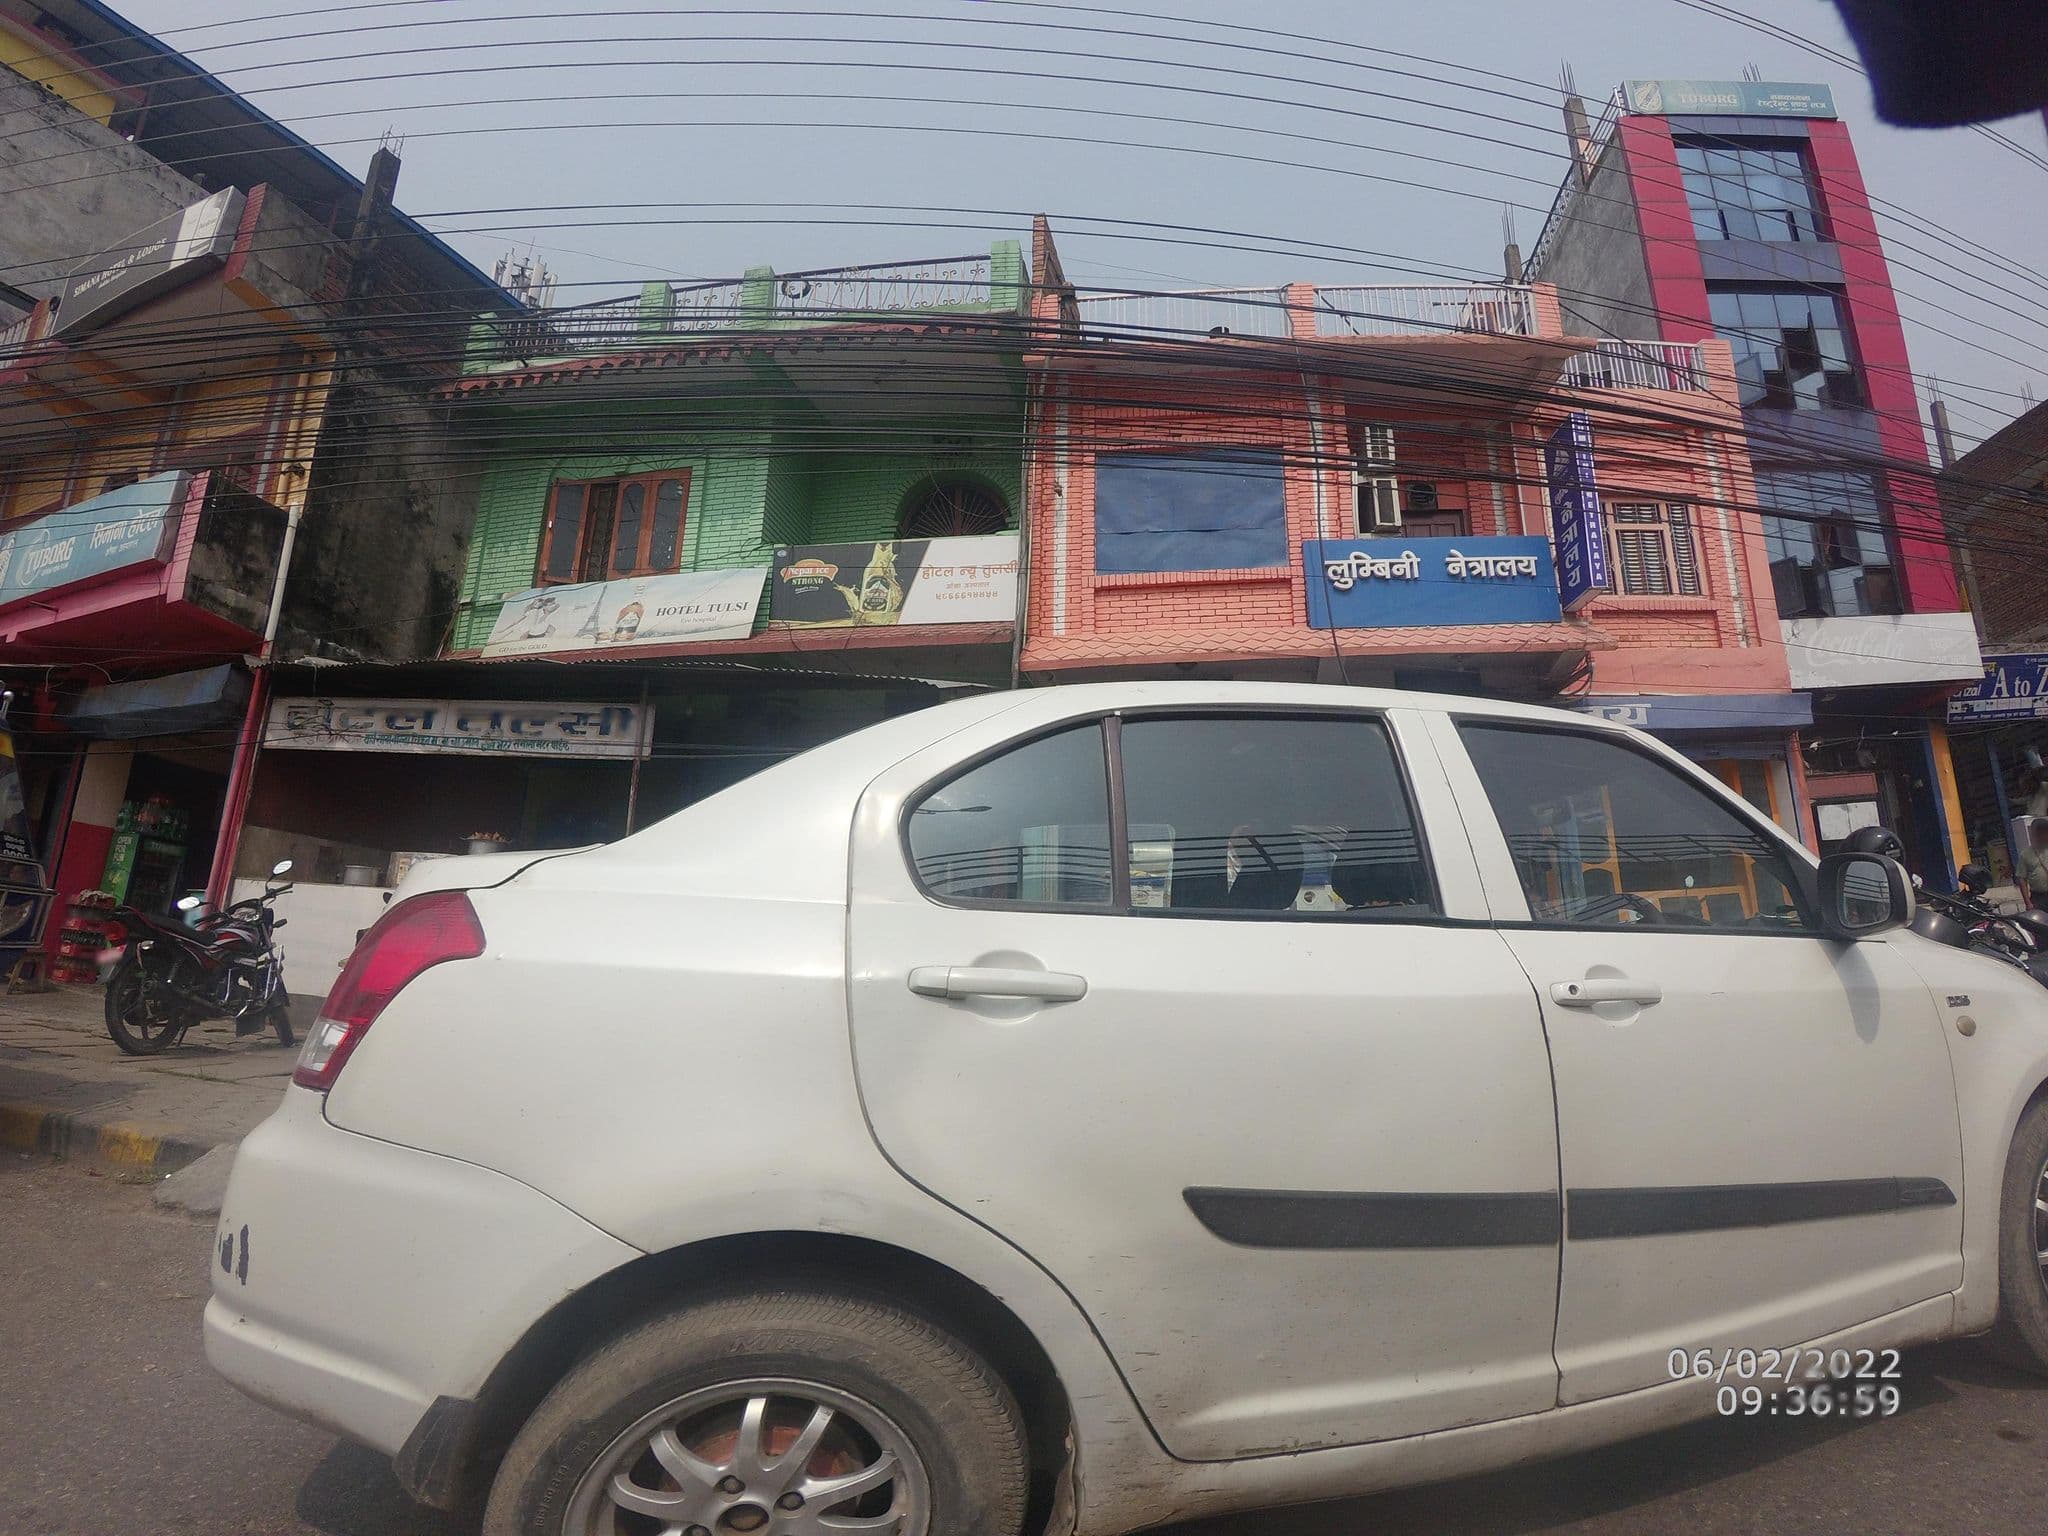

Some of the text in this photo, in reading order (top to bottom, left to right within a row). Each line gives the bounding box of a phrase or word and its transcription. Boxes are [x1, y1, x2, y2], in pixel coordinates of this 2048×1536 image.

[25, 536, 77, 575] TUBORG
[791, 577, 825, 586] STRONG
[921, 564, 955, 580] होटल
[982, 560, 1020, 578] तुलसी
[1324, 549, 1538, 591] लुम्बिनी नेत्रालय
[656, 601, 750, 617] HOTEL TULSI
[1990, 667, 2010, 698] A
[2014, 675, 2031, 697] to
